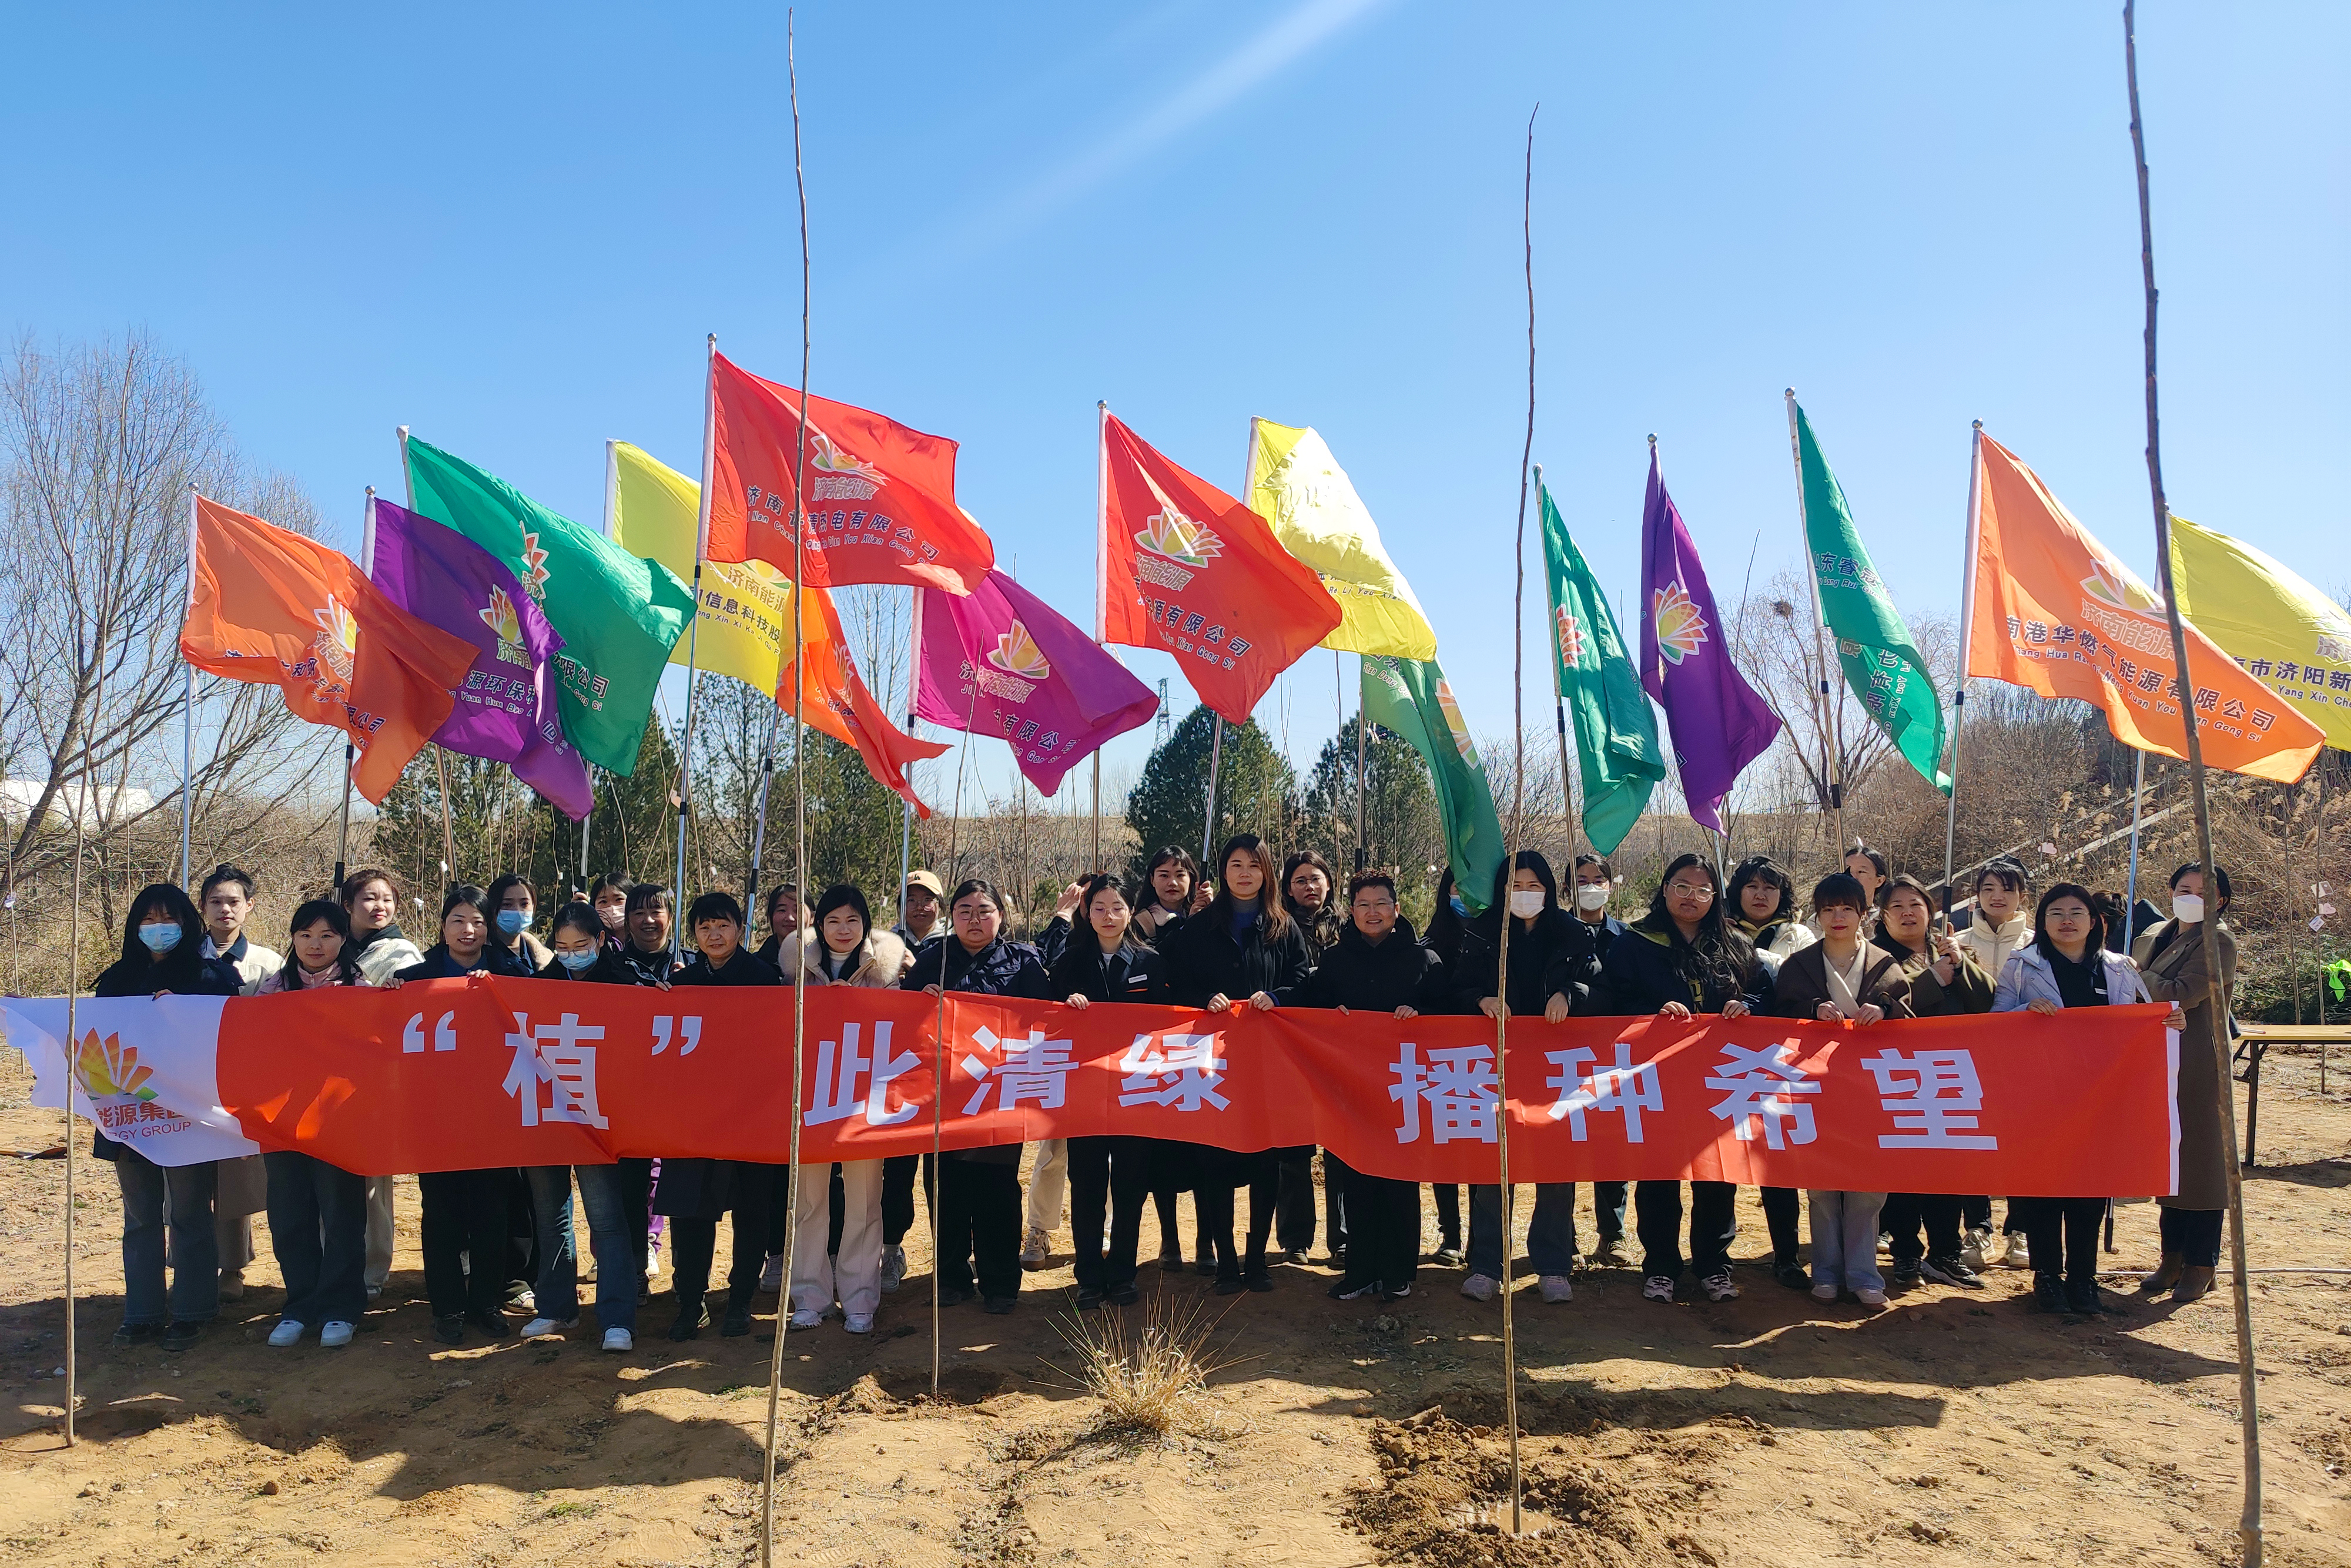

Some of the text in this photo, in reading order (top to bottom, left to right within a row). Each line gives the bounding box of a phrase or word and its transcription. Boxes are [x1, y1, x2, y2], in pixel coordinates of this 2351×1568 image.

[752, 511, 769, 524] Nan
[774, 521, 795, 544] Chan
[845, 534, 858, 544] You
[861, 533, 883, 545] Xian
[889, 540, 915, 558] Gong
[1328, 585, 1338, 594] Re
[1342, 585, 1353, 594] Li
[1358, 587, 1375, 596] You
[1823, 577, 1839, 588] Dong
[1841, 578, 1858, 589] Rui
[715, 614, 729, 624] Xin
[733, 619, 742, 628] Xi
[764, 640, 772, 651] Gu
[1177, 636, 1193, 652] Xian
[1197, 645, 1220, 664] Gong
[1222, 656, 1235, 670] Si
[1377, 669, 1398, 688] Dong
[461, 691, 481, 704] Yuan
[485, 696, 504, 709] Huan
[2046, 648, 2068, 659] Hua
[2102, 670, 2124, 694] Neng
[2128, 688, 2149, 709] Yuan
[2155, 701, 2178, 715] You
[2213, 720, 2243, 738] Gong
[2248, 732, 2263, 743] Si
[2278, 685, 2303, 700] Yang
[2310, 691, 2328, 703] Xin
[591, 699, 603, 712] Si
[1388, 1043, 1998, 1150] 播种希望
[141, 1121, 192, 1137] GROUP
